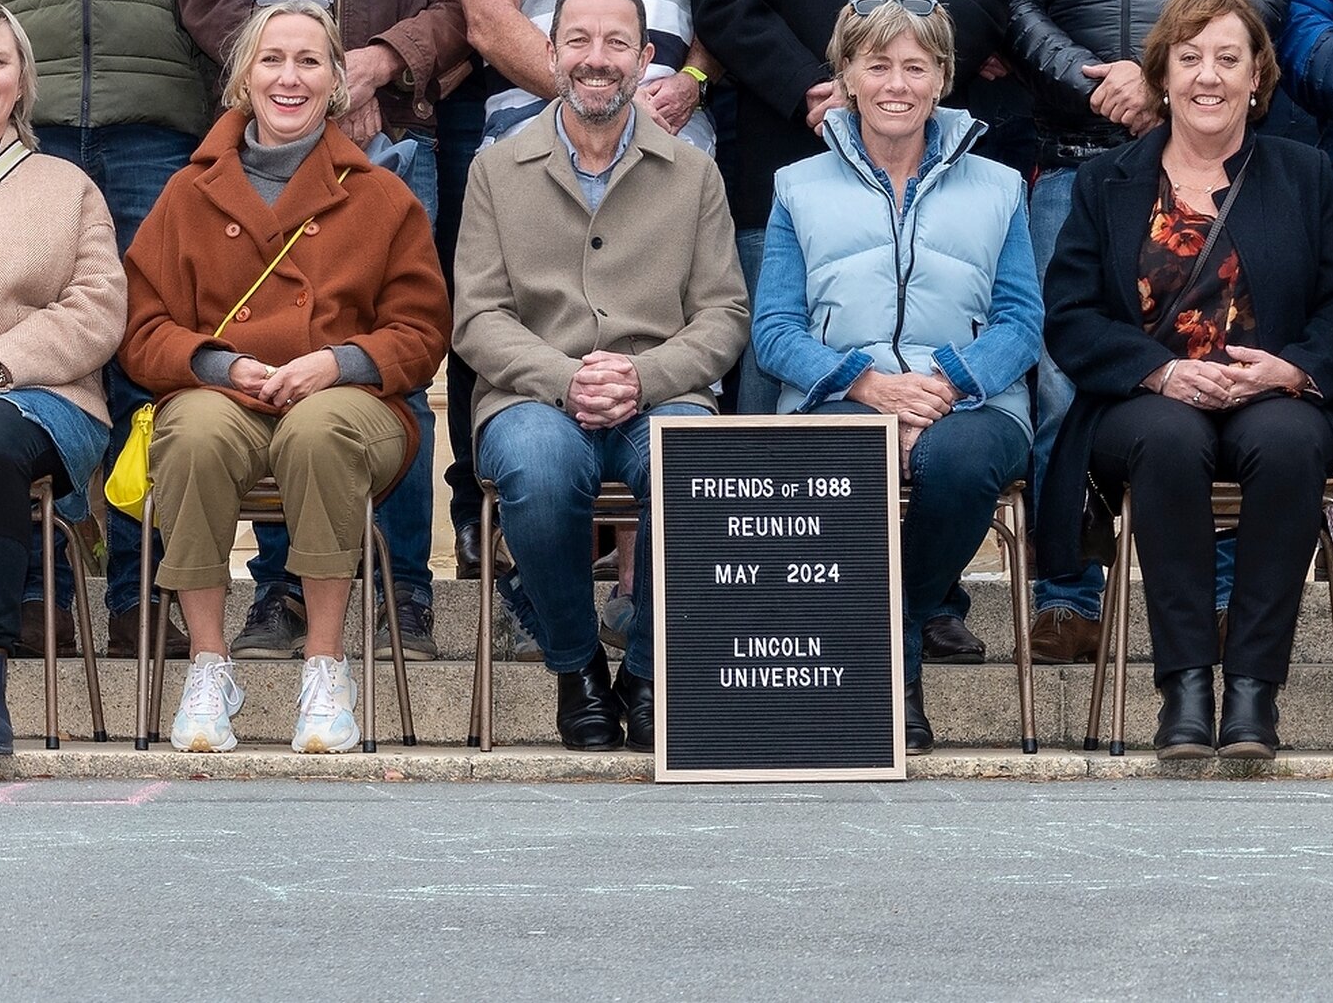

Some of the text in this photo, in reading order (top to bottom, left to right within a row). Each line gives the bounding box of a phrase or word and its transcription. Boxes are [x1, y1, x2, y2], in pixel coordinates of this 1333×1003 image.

[691, 477, 852, 498] FRIENDS OF 1988
[728, 516, 821, 536] REUNION
[715, 563, 841, 584] MAY 2024
[733, 637, 821, 657] LINCOLN
[719, 667, 845, 687] UNIVERSITY
